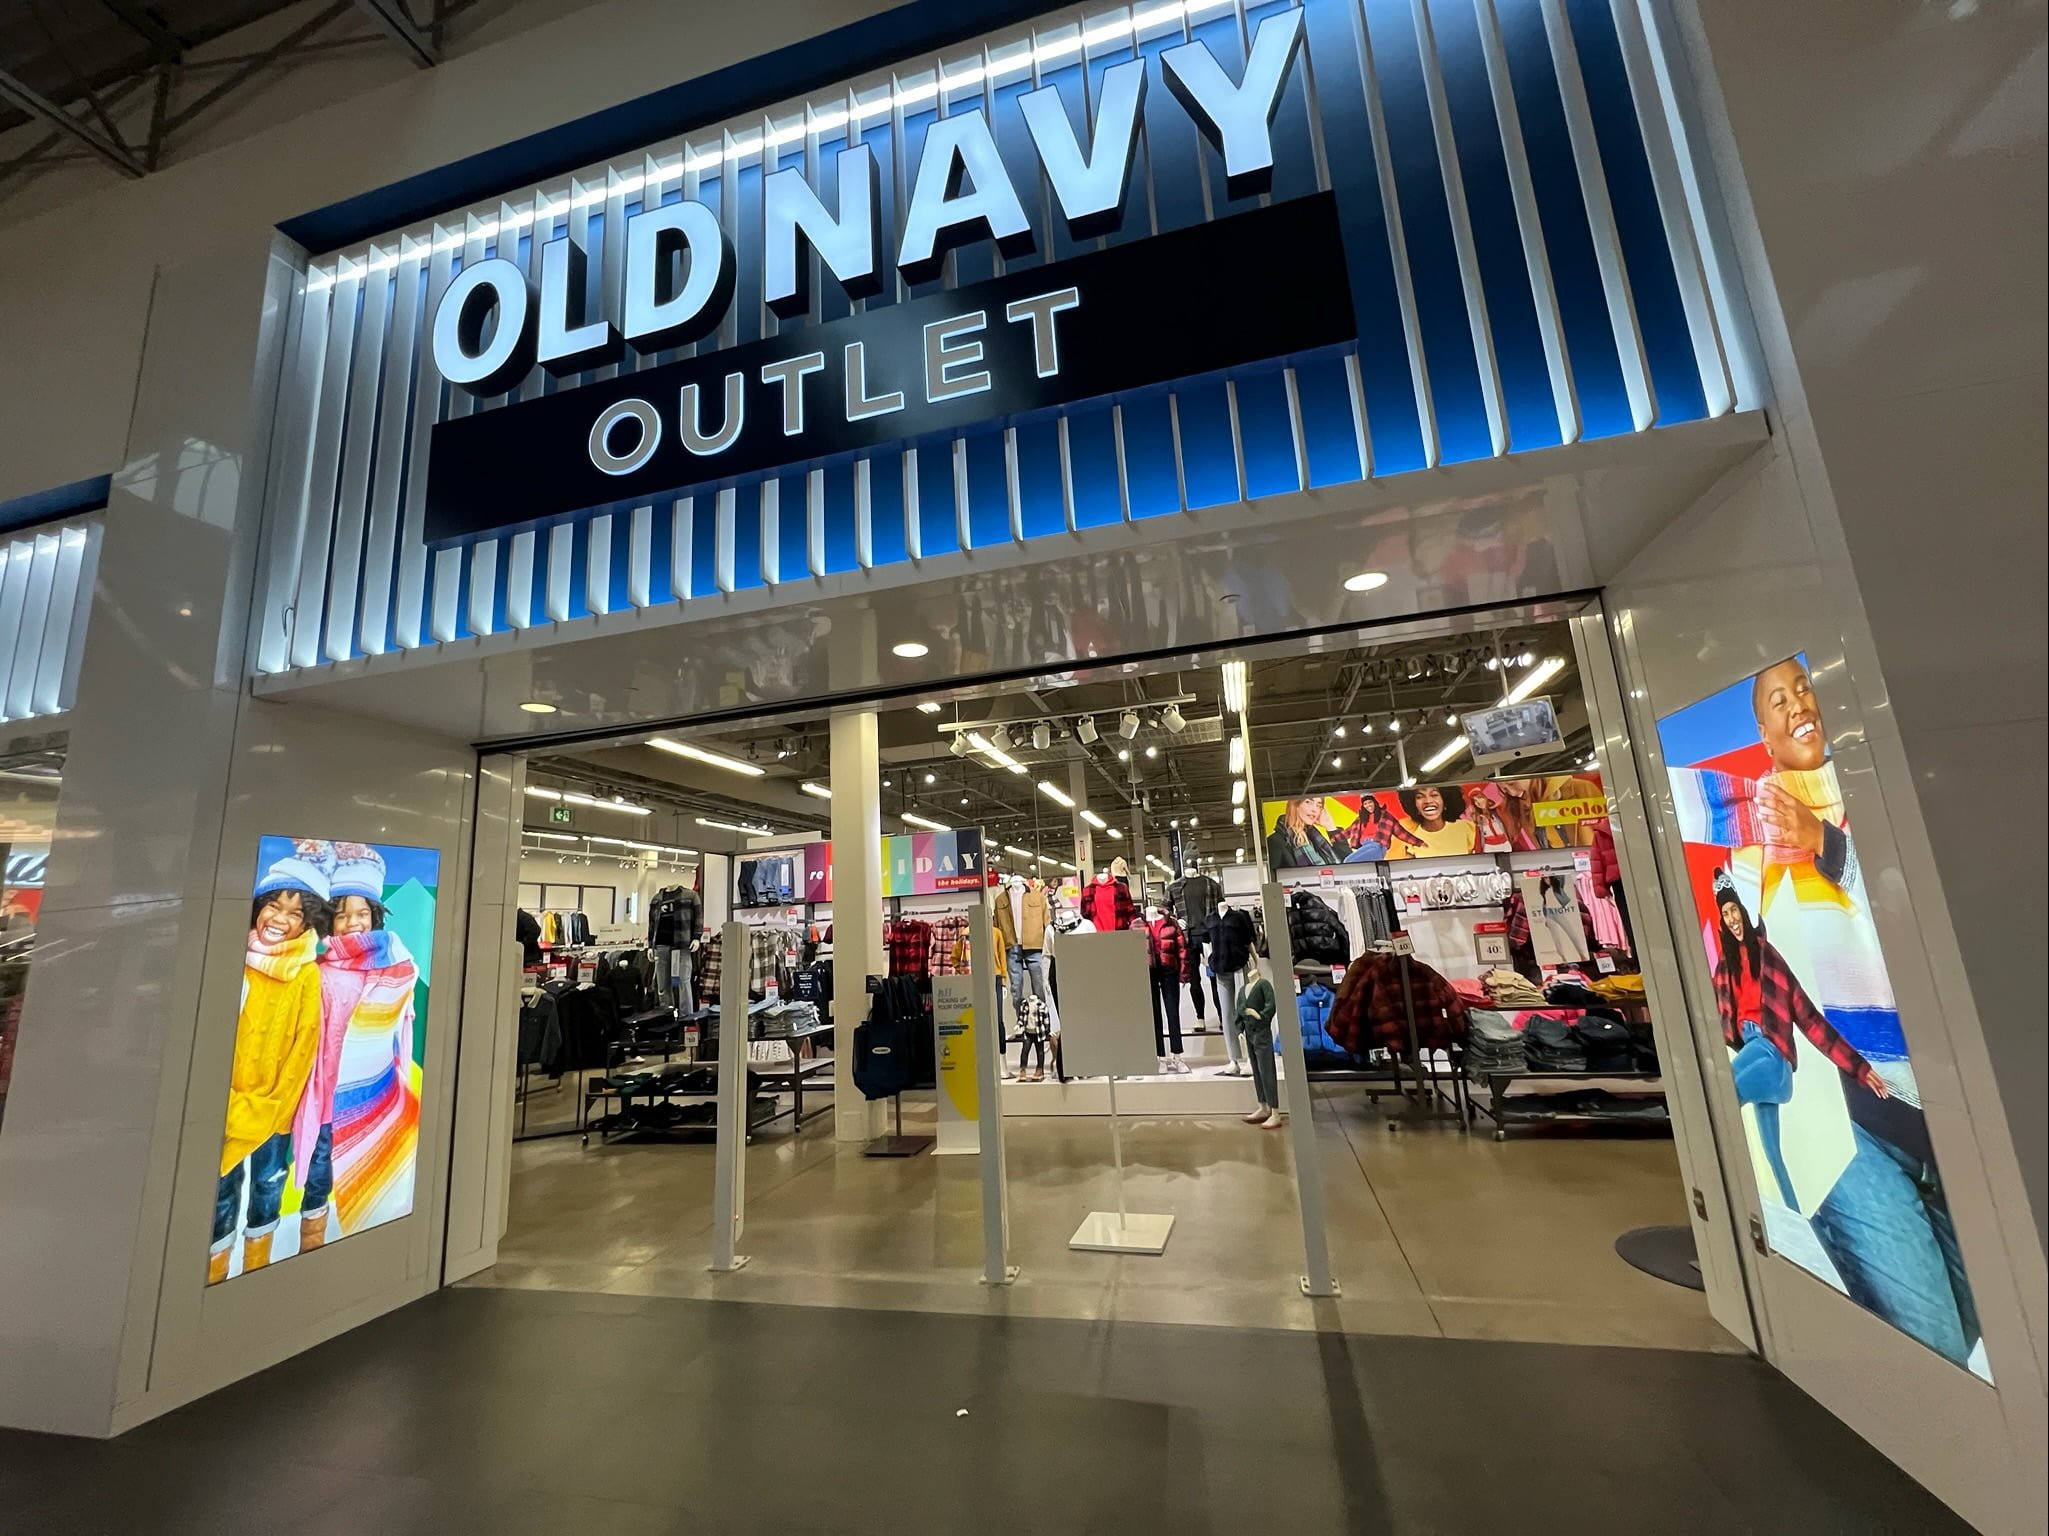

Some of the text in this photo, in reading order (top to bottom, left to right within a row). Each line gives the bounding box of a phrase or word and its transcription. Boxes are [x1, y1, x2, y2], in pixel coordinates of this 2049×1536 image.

[432, 5, 1306, 390] OLD NAVY
[588, 286, 1080, 476] OUTLET
[809, 869, 824, 881] re
